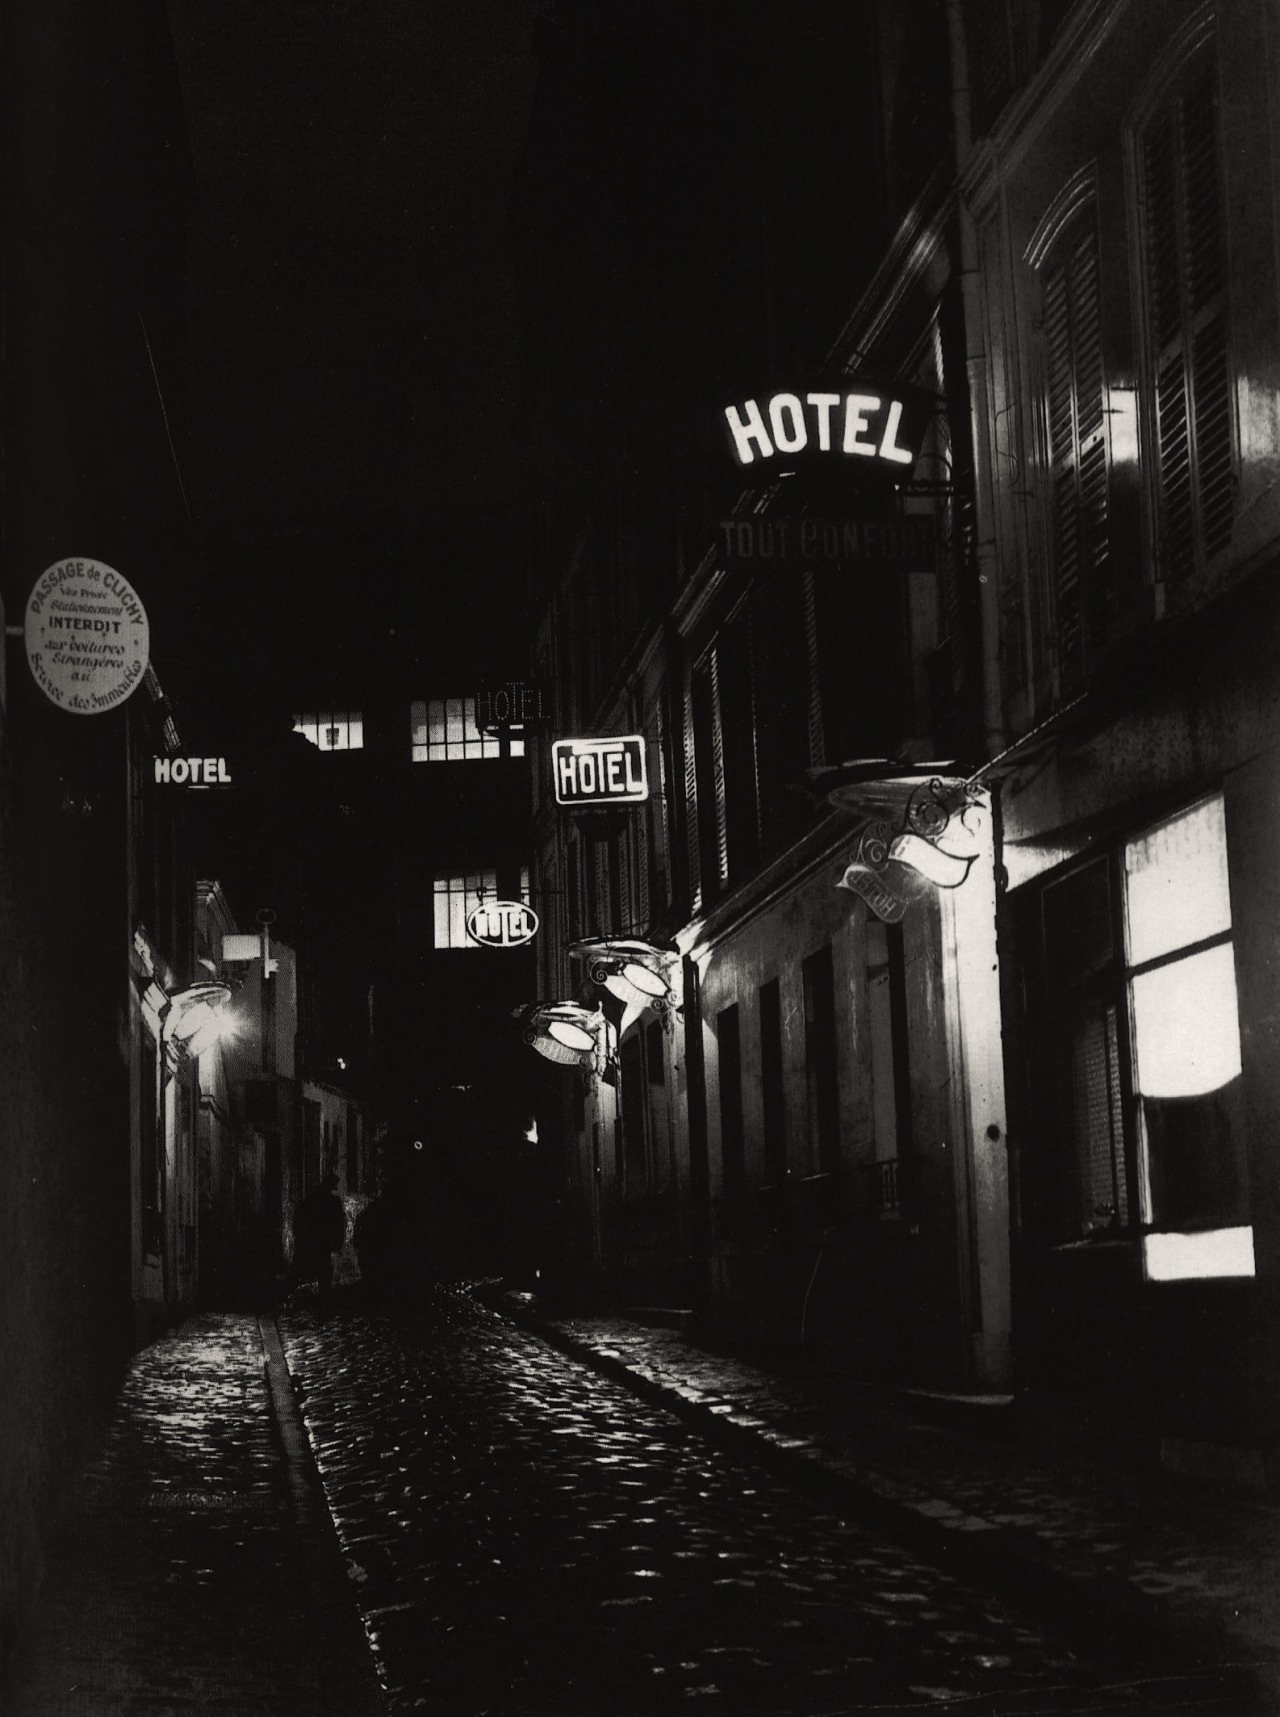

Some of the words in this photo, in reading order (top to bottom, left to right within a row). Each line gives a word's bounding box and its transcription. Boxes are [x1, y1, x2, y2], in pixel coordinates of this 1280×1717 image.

[724, 392, 913, 465] HOTEL
[719, 520, 789, 560] TOUT
[31, 562, 85, 615] PASSAGE
[87, 565, 101, 582] de
[103, 571, 145, 625] CLICHY
[49, 616, 122, 634] INTERDIT
[476, 681, 551, 722] HOTEL
[154, 757, 232, 783] HOTEL
[558, 742, 645, 796] HOTEL
[475, 906, 532, 944] HOTEL
